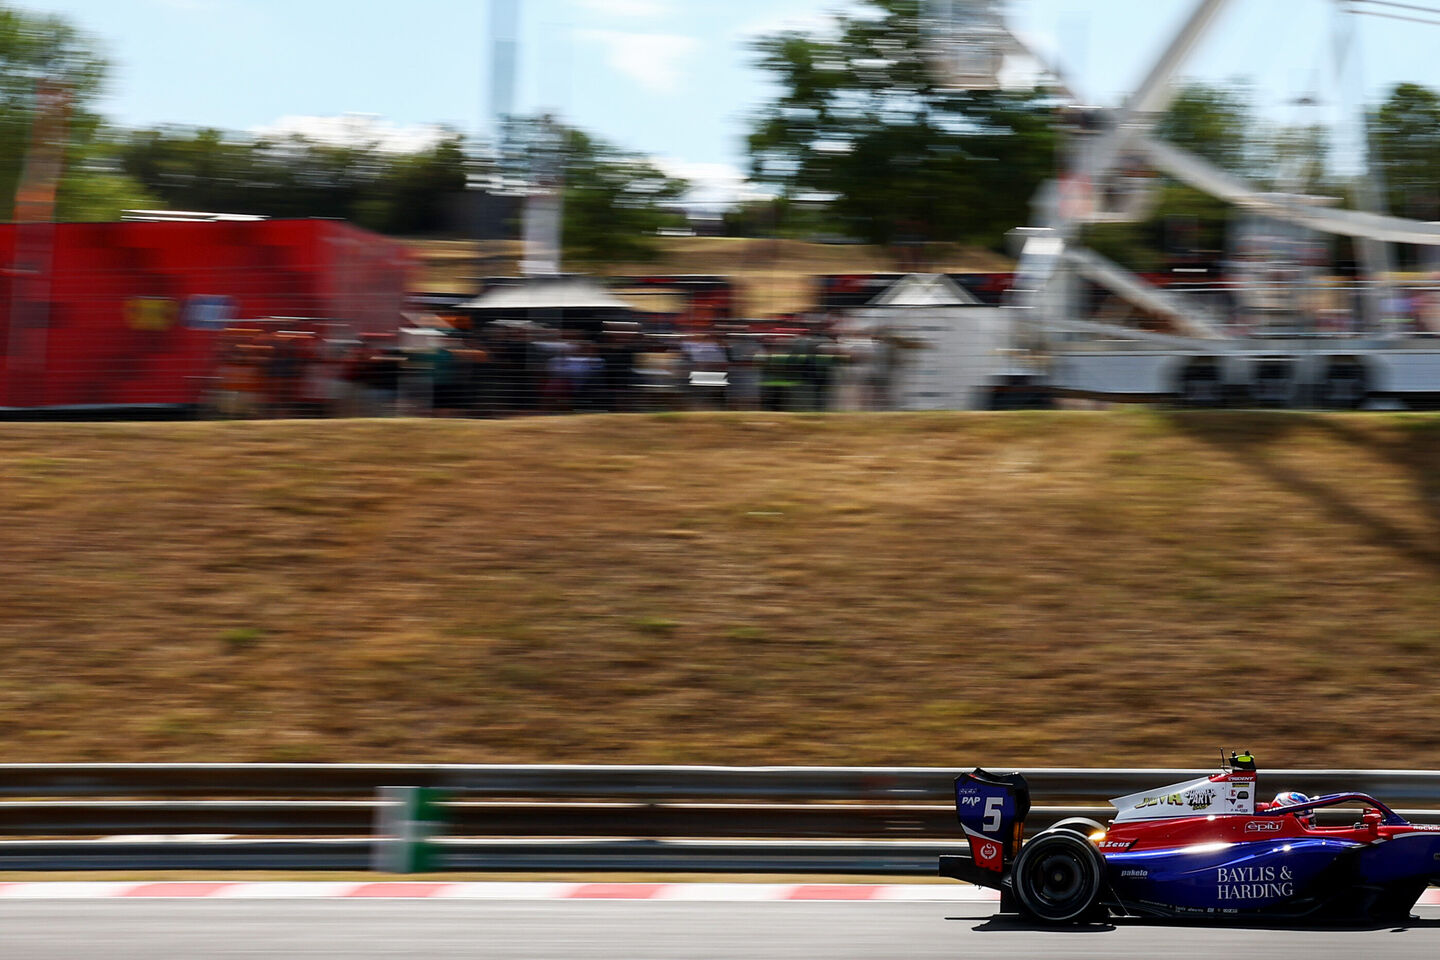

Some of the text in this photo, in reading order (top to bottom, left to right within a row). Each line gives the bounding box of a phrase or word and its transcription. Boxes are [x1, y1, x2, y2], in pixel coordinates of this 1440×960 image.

[1187, 793, 1214, 805] PARTY
[982, 796, 1004, 832] 5
[1217, 865, 1293, 882] BAYLIS &
[1217, 882, 1293, 899] HARDING
